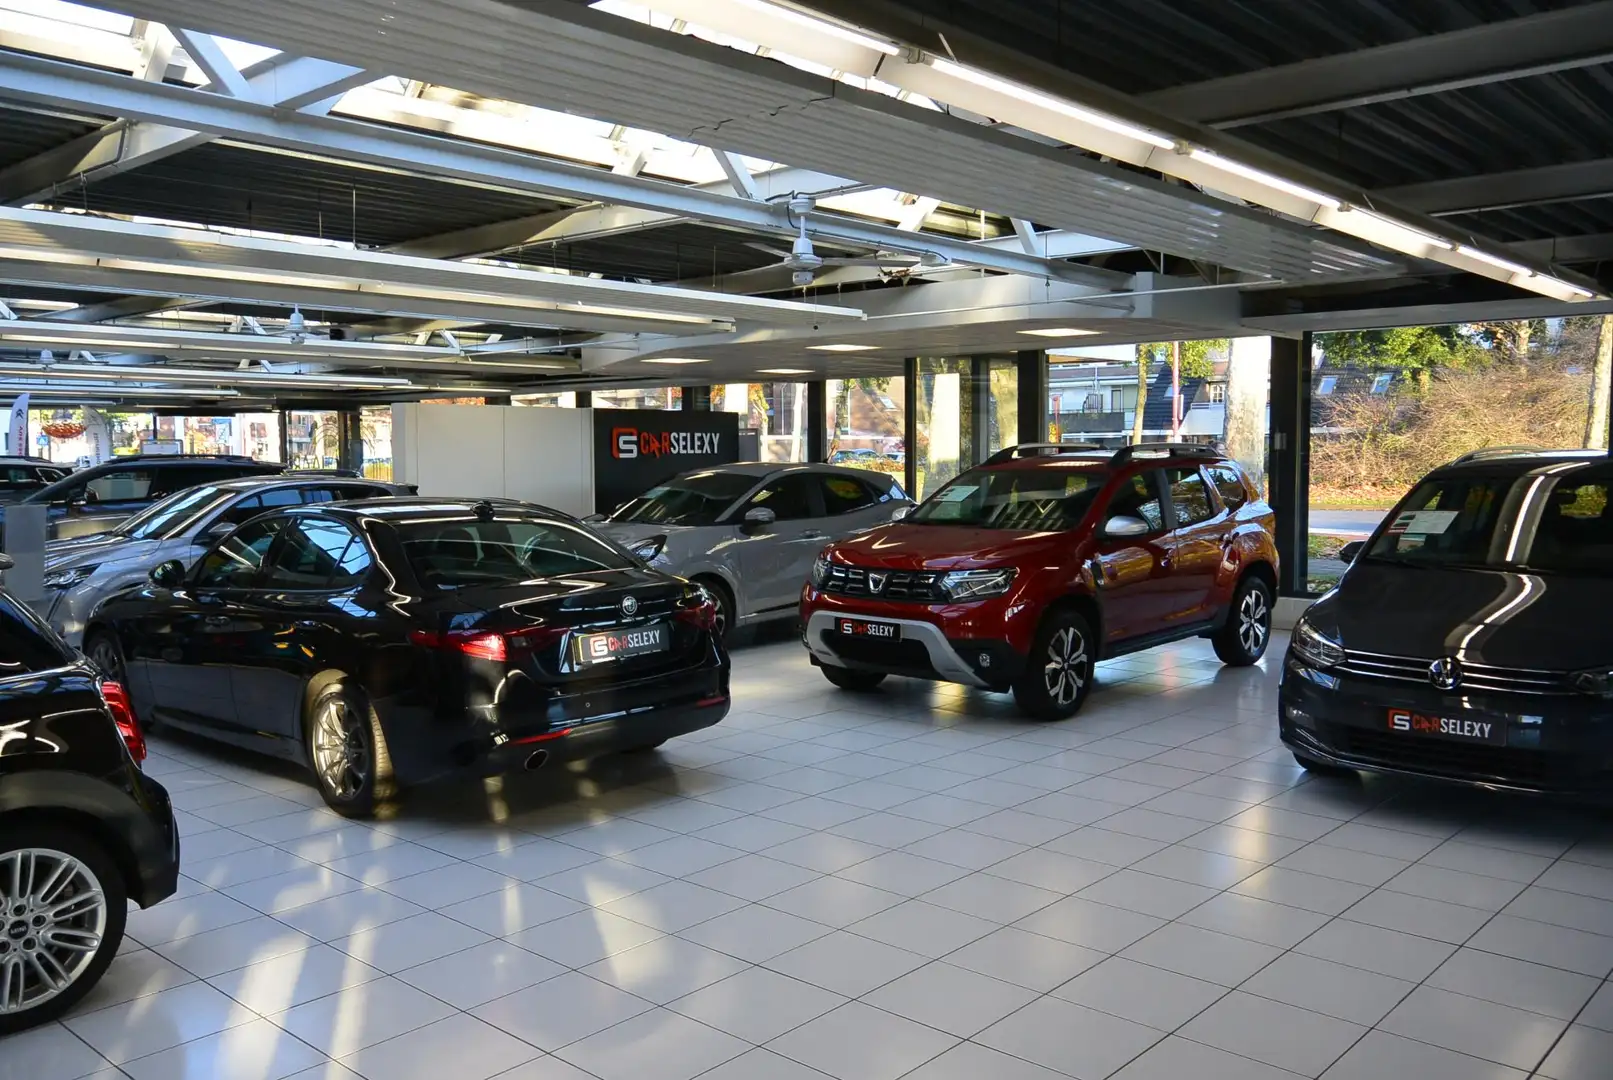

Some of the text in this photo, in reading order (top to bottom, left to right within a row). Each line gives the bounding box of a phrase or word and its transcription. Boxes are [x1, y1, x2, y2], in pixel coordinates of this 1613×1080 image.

[640, 431, 720, 458] CARSELEXY
[608, 630, 660, 652] CARSELEXY
[1412, 715, 1491, 738] CARSELEXY
